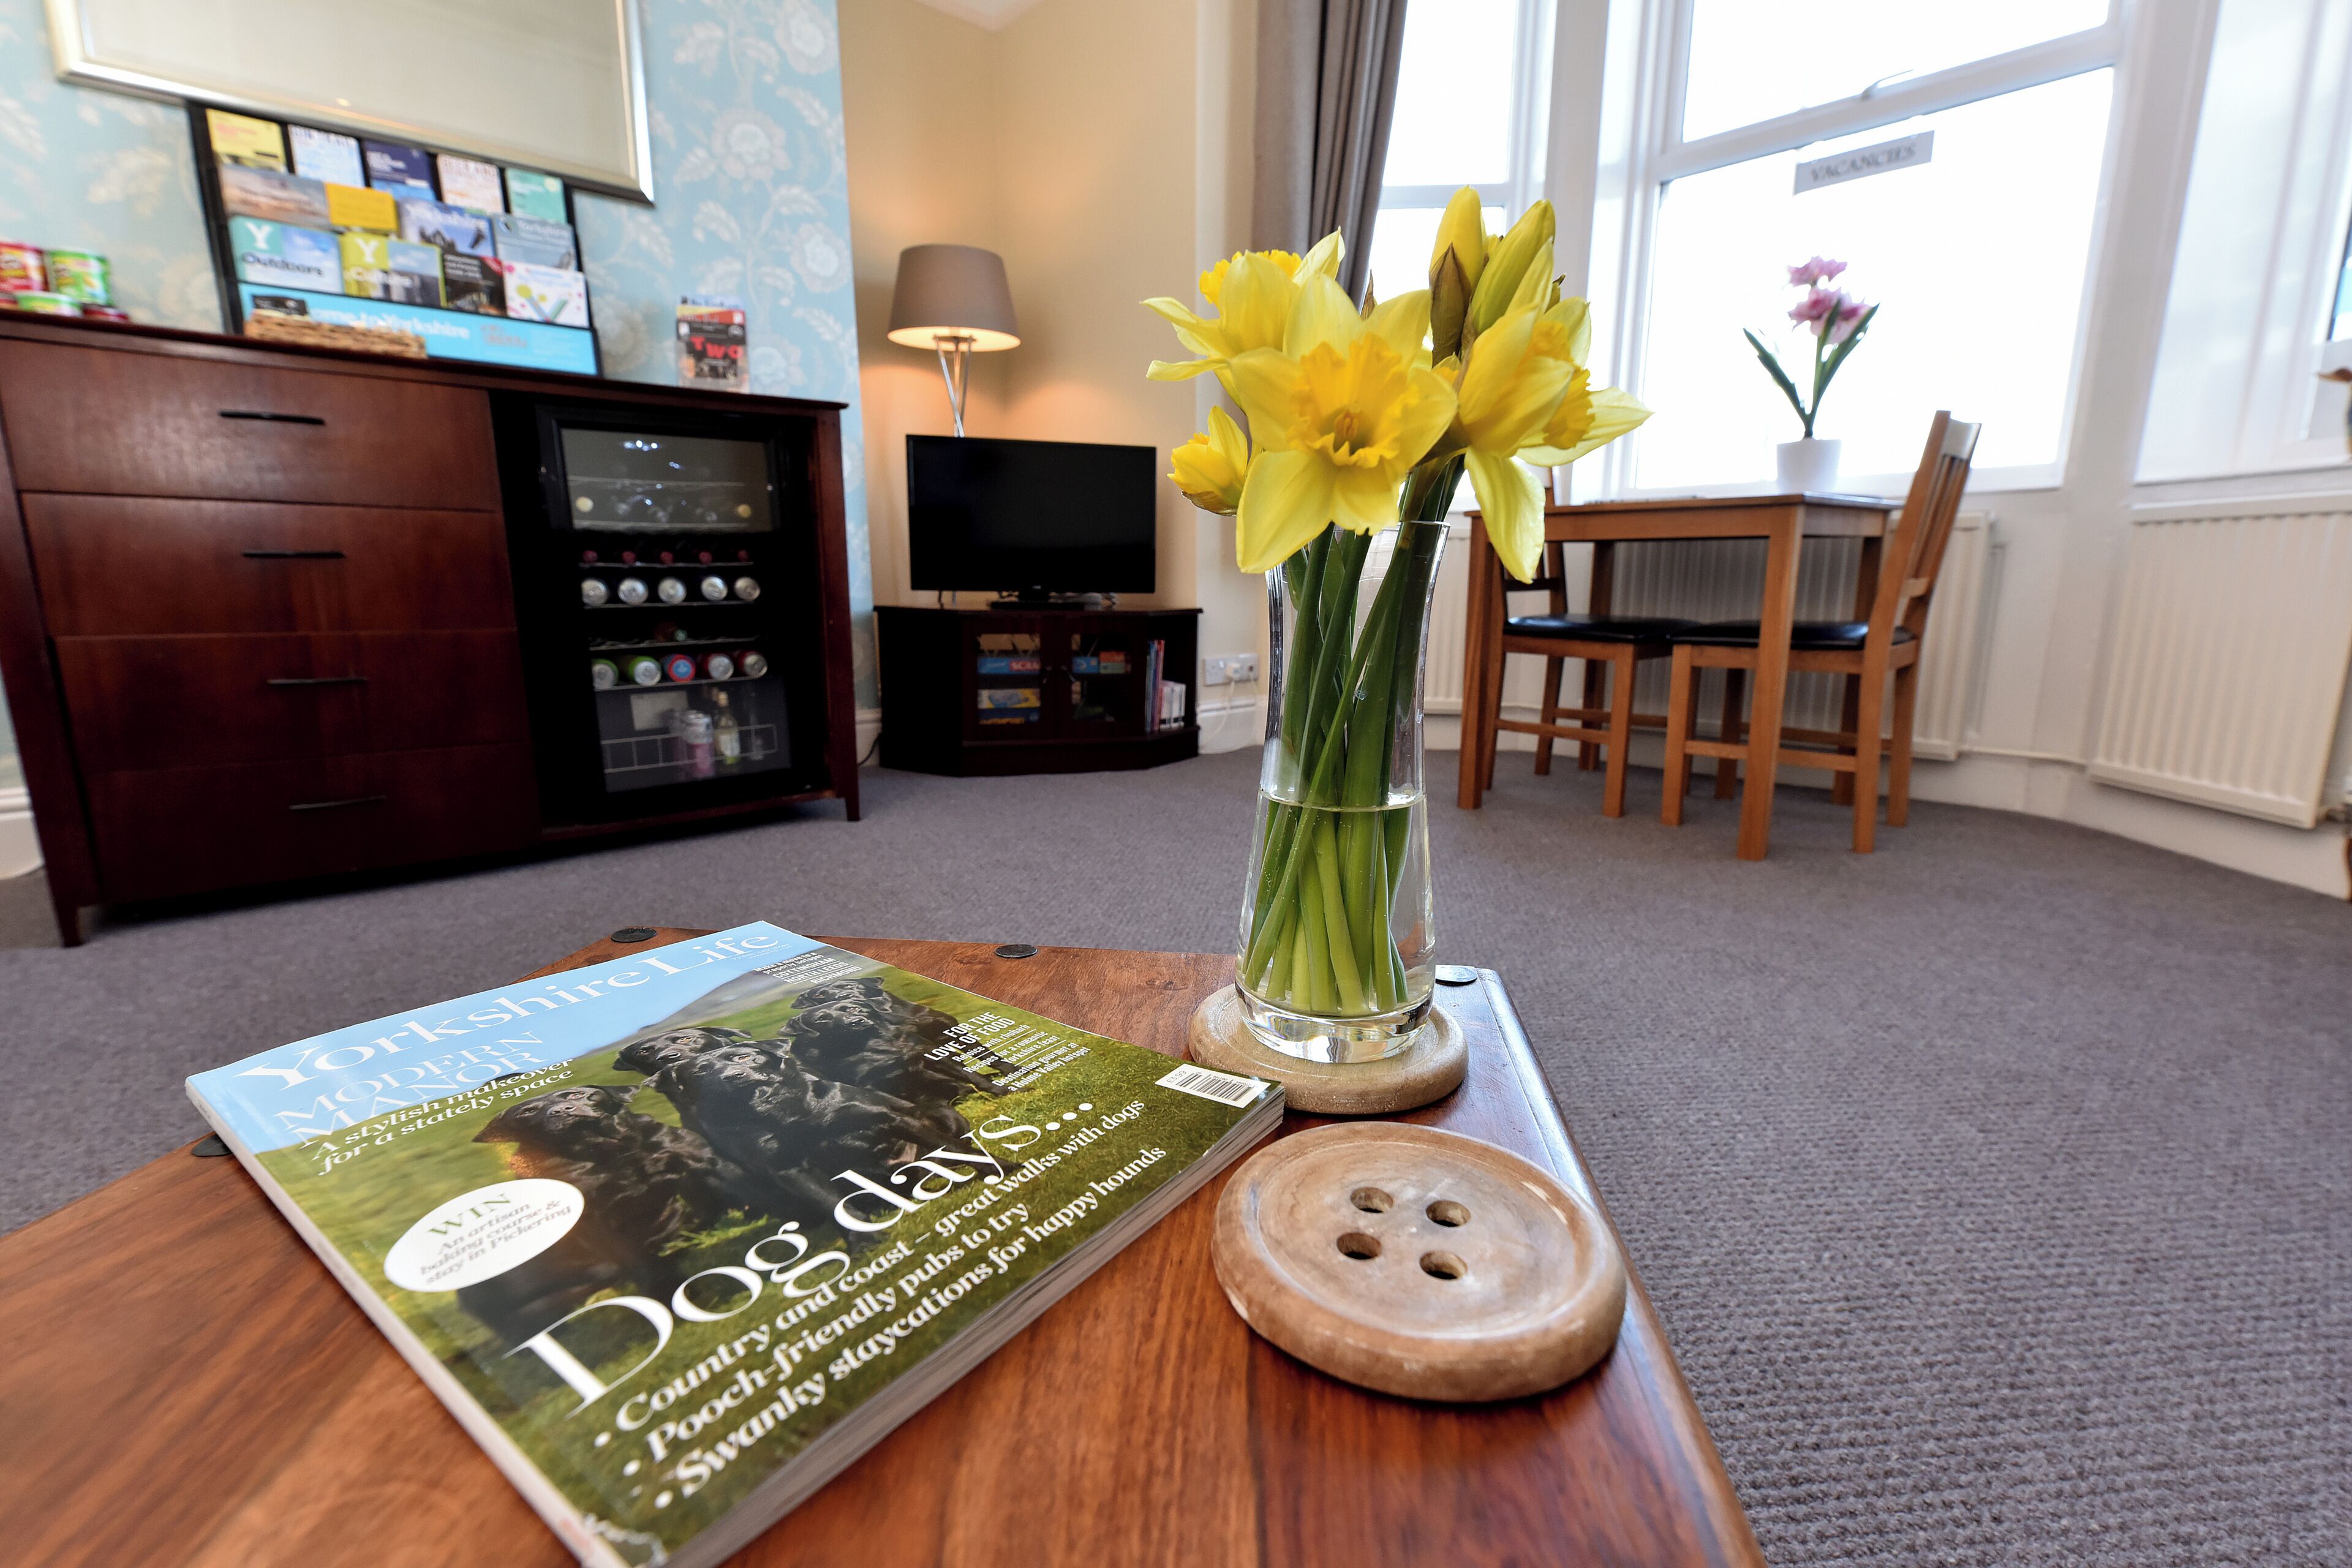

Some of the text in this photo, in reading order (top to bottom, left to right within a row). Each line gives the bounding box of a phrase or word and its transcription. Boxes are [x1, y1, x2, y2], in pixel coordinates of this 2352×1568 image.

[243, 251, 324, 275] Outdoors
[772, 957, 837, 978] COTTINGHAM
[784, 962, 850, 984] NORTH LEEDS
[809, 966, 862, 984] RICHMOND
[233, 936, 778, 1091] Yorkshire Life
[943, 1011, 1001, 1038] FOR THE
[924, 1017, 1016, 1061] LOVE OF FOOD
[951, 1024, 1031, 1063] Rejoice with rhubarb
[963, 1054, 1000, 1074] Recipes
[995, 1047, 1011, 1058] for
[1014, 1030, 1049, 1049] romantic
[1001, 1035, 1060, 1065] Yorkshire feast
[274, 1030, 544, 1129] MODERN
[992, 1060, 1041, 1087] Destination
[1038, 1047, 1072, 1065] gourmet
[1012, 1071, 1042, 1088] Holme
[1039, 1058, 1066, 1074] Valley
[1063, 1046, 1092, 1063] hotspot
[290, 1052, 548, 1150] MANOR
[312, 1058, 575, 1160] A stylish makeover
[318, 1068, 574, 1176] for a stately space
[420, 1199, 563, 1275] baking course &
[428, 1193, 511, 1235] WIN
[437, 1202, 531, 1255] An artisan
[426, 1205, 572, 1284] stay in Pickering
[503, 1102, 1094, 1419] Dog days...
[615, 1323, 771, 1431] Country
[774, 1281, 839, 1330] and
[837, 1242, 915, 1294] coast
[934, 1187, 1002, 1237] great
[996, 1152, 1062, 1194] walks
[1057, 1126, 1105, 1157] with
[1101, 1099, 1145, 1131] dogs
[644, 1202, 1030, 1463] Pooch-friendly pubs to try
[675, 1145, 1167, 1494] Swanky staycations for happy hounds
